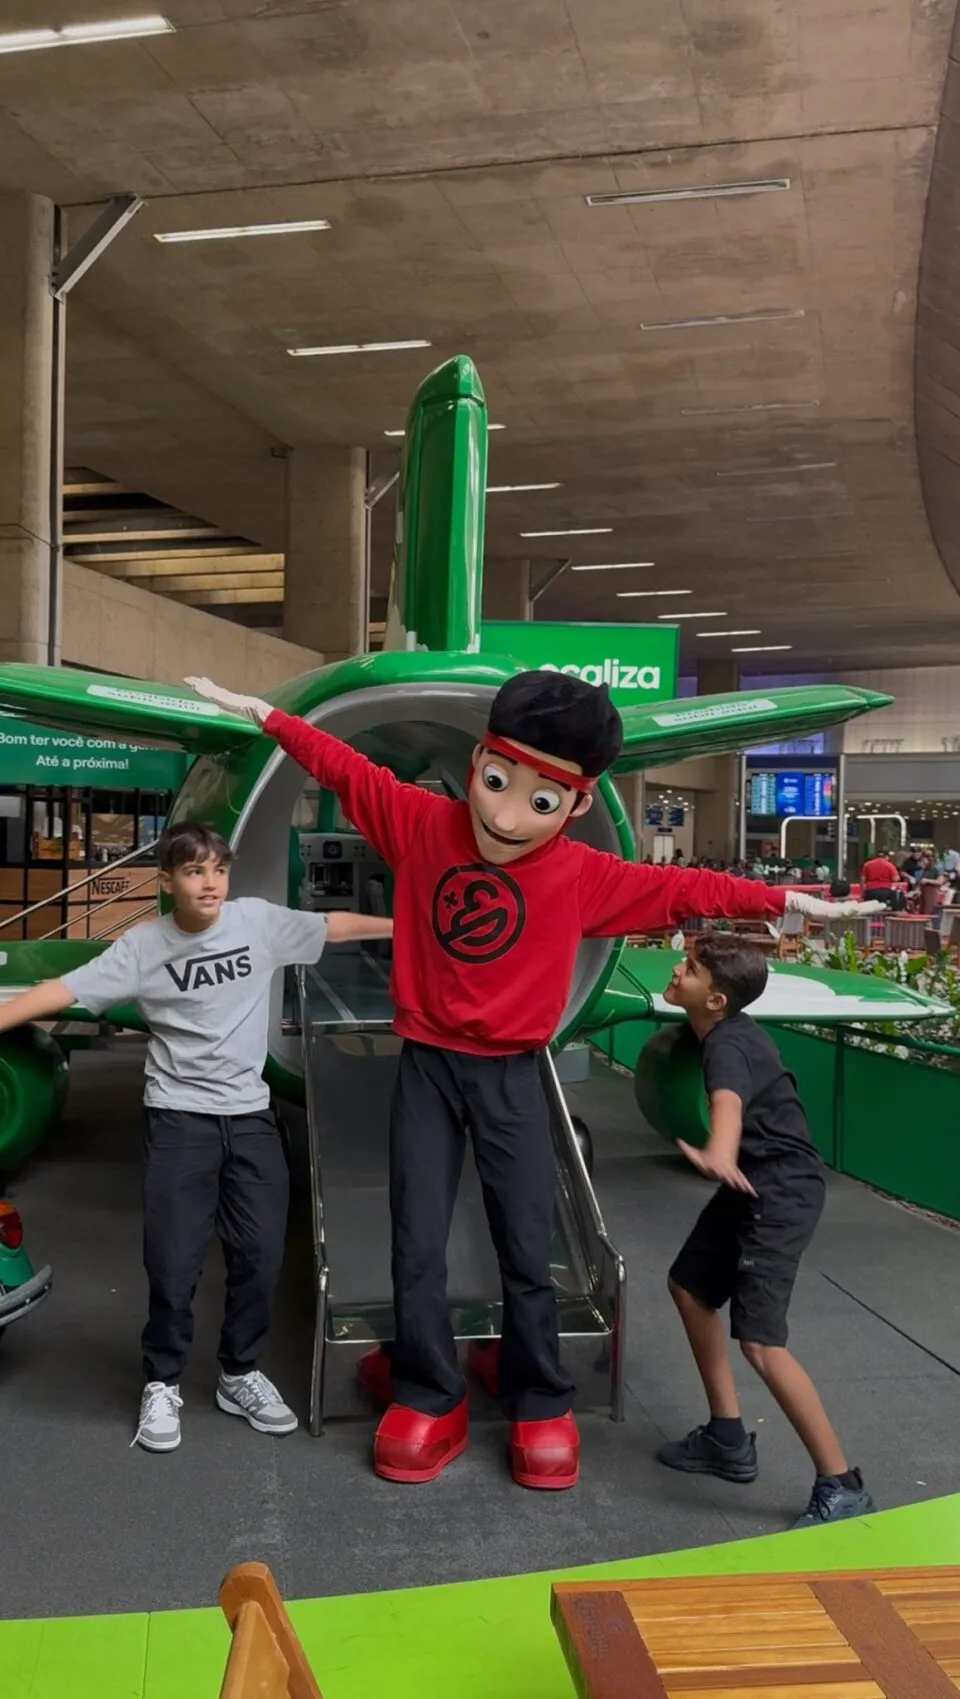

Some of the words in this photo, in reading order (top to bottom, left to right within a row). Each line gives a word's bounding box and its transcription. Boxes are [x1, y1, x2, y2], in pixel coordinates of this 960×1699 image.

[30, 735, 49, 746] ter
[52, 736, 84, 748] você
[87, 738, 116, 749] com
[36, 755, 59, 767] Até
[62, 758, 70, 767] a
[73, 756, 129, 770] próxima!
[164, 945, 252, 992] VANS
